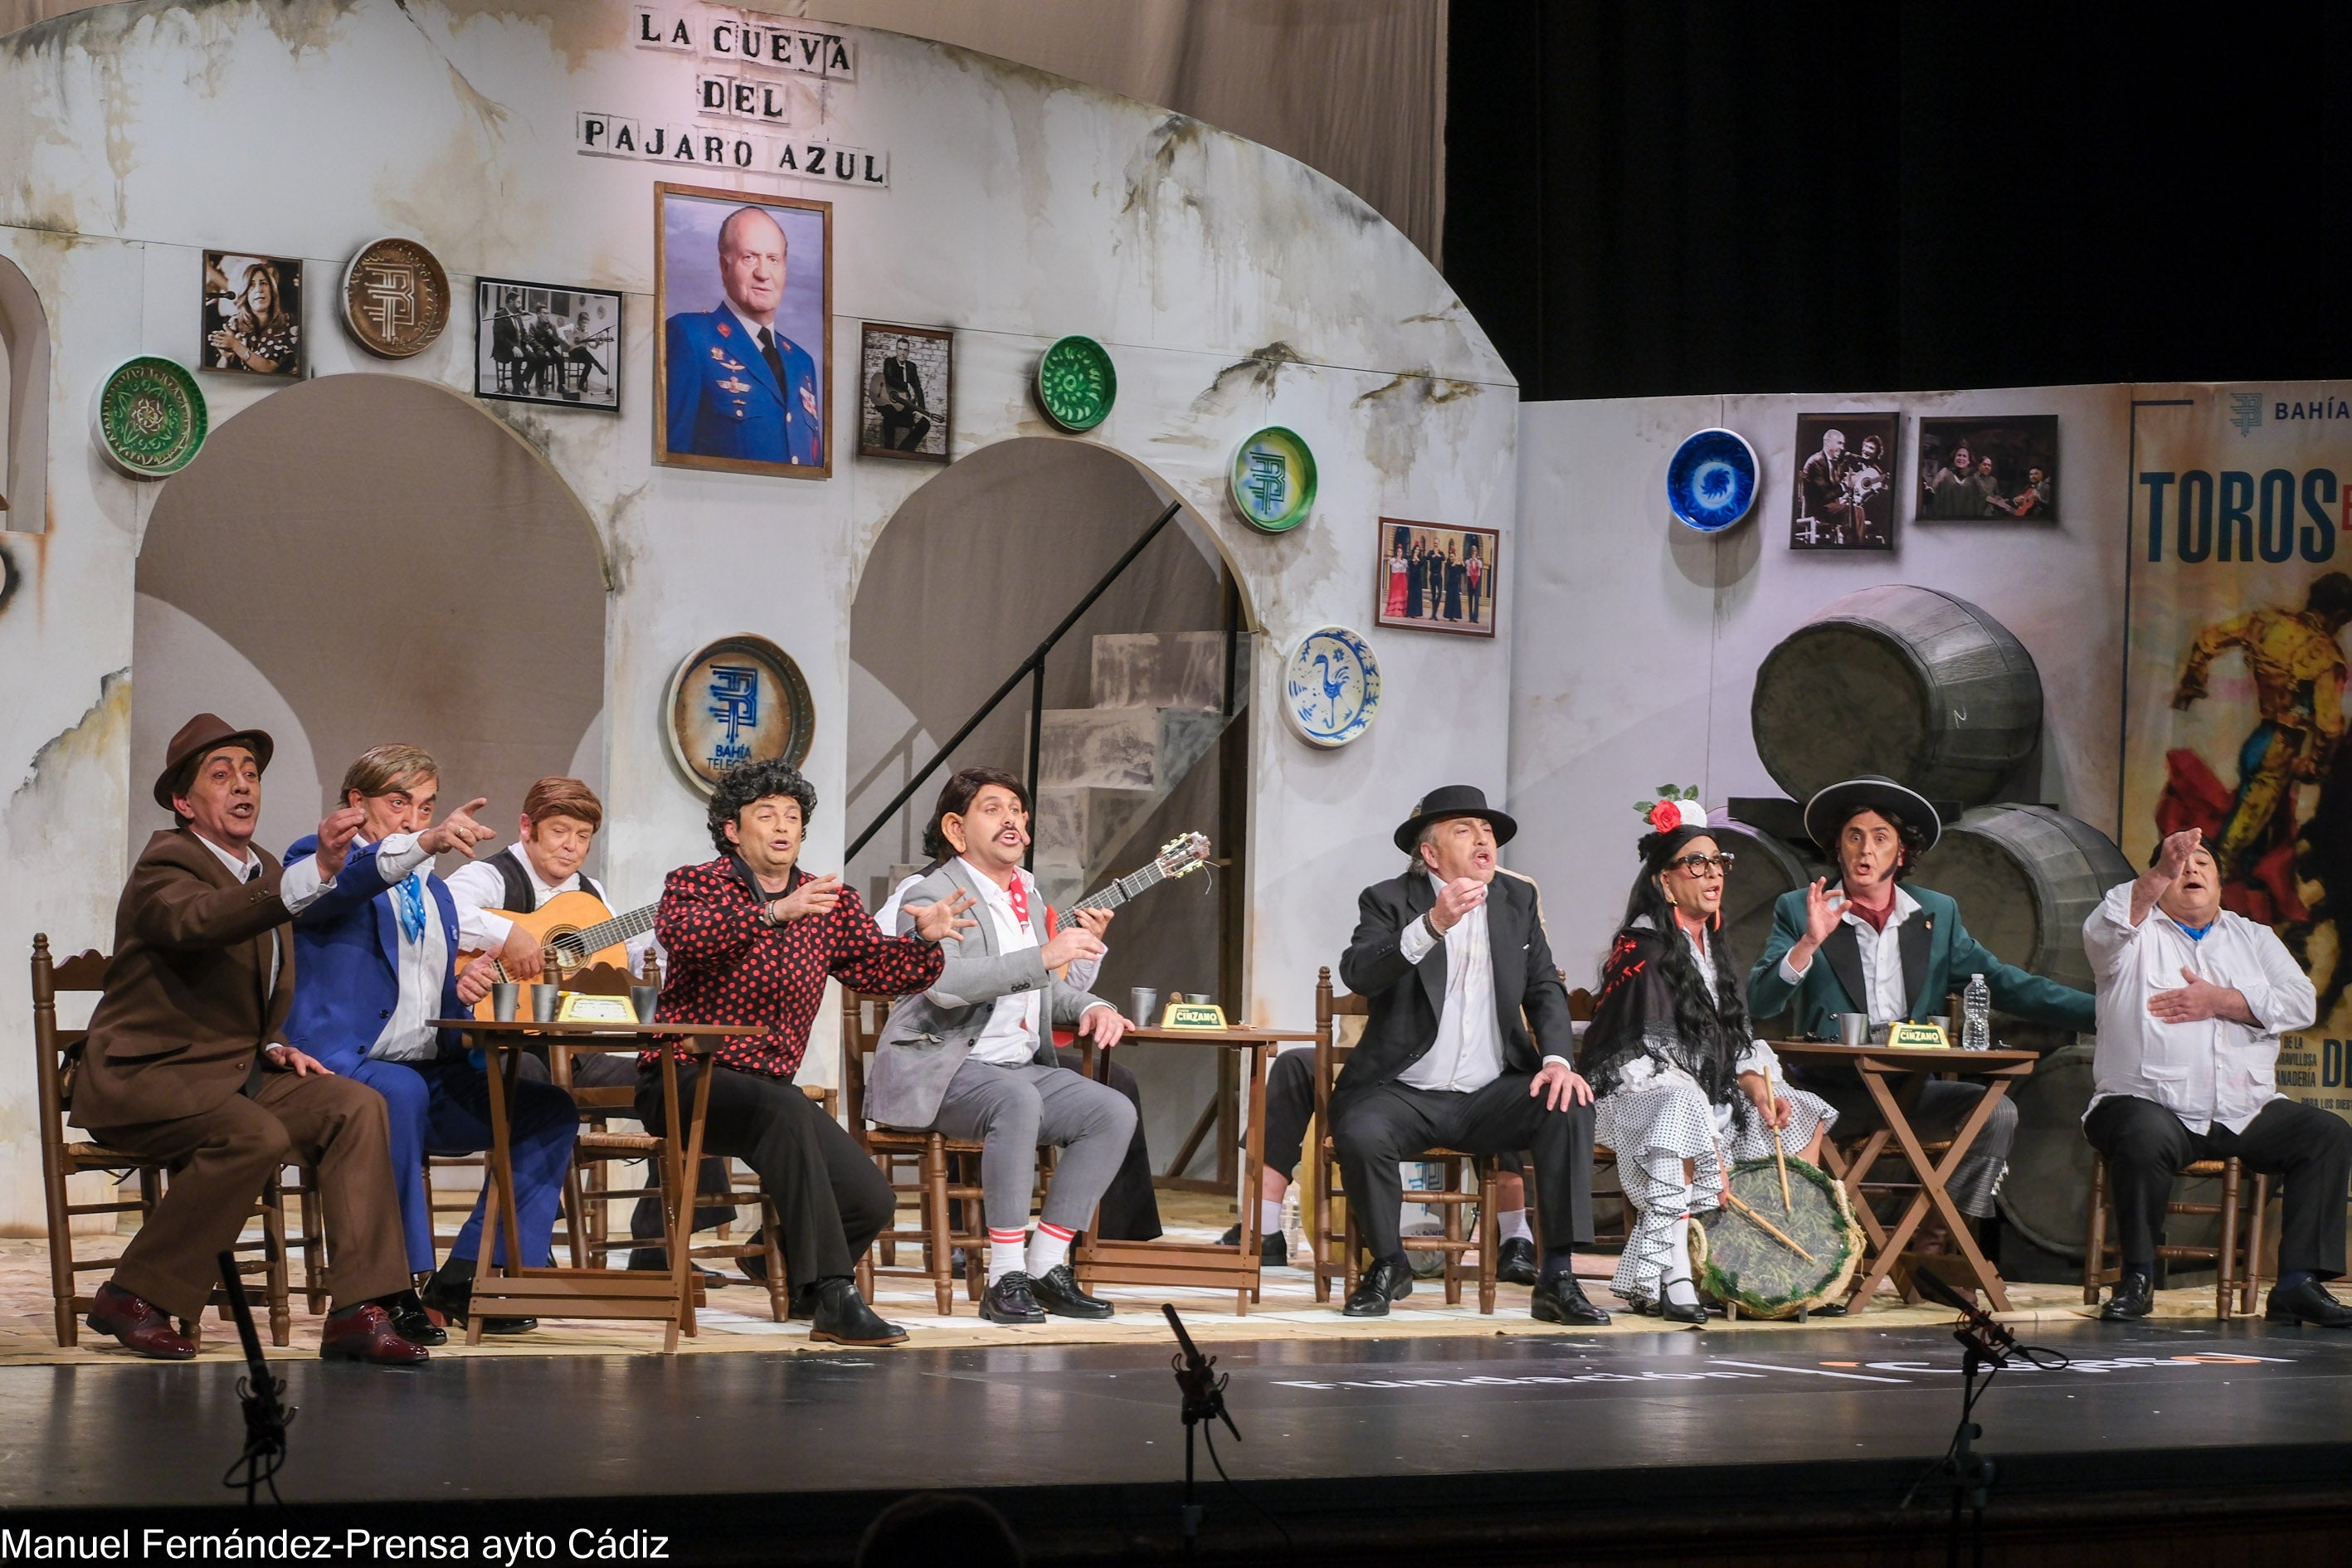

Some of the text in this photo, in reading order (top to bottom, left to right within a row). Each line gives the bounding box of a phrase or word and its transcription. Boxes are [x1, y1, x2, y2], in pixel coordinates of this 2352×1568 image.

[640, 13, 850, 71] LA CUEVA
[703, 80, 782, 117] DEL
[585, 119, 884, 183] PAJARO AZUL
[2274, 396, 2350, 420] BAHÍA
[2140, 468, 2337, 563] TOROS
[715, 743, 752, 760] BAHÍA
[1176, 1011, 1217, 1022] CINZANO
[1900, 1031, 1939, 1041] CINZANO
[2284, 1035, 2303, 1049] DE LA
[2275, 1067, 2316, 1087] ANADERÍA
[1269, 1371, 1768, 1390] Fundación
